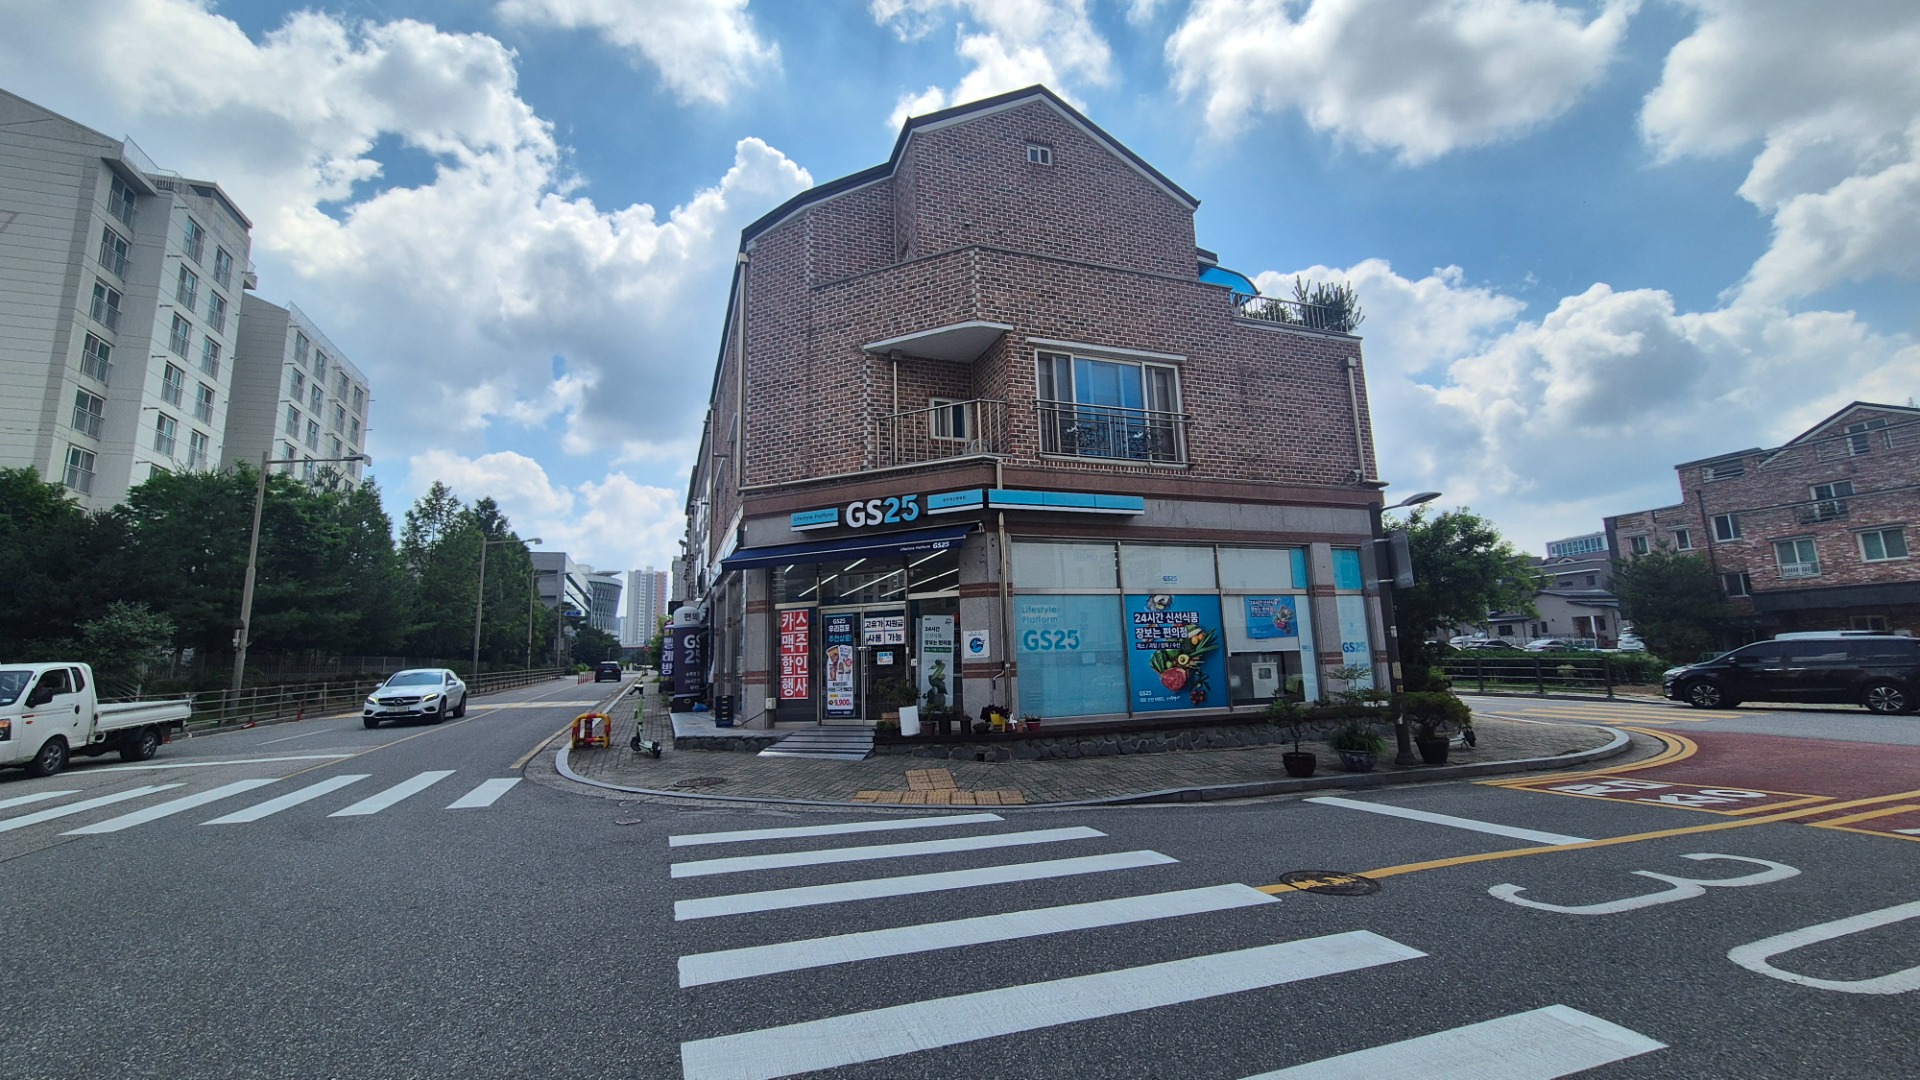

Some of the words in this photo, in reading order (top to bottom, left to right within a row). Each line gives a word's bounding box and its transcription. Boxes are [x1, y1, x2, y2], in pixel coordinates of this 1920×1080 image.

[845, 494, 920, 528] GS25
[933, 541, 950, 549] GS25
[1022, 605, 1057, 615] Lifestyle
[782, 612, 808, 631] 카스
[865, 620, 883, 628] 고유가
[1134, 612, 1164, 624] 24시간
[1165, 612, 1198, 624] 신선식품
[828, 624, 850, 633] 우리점포
[1136, 627, 1162, 639] 장보는
[1163, 626, 1188, 639] 편의점
[782, 633, 808, 652] 맥주
[868, 633, 882, 643] 사용
[888, 632, 902, 642] 가능
[1023, 629, 1080, 651] GS25
[1342, 641, 1367, 653] GS25
[782, 655, 808, 674] 할인
[782, 677, 808, 697] 행사
